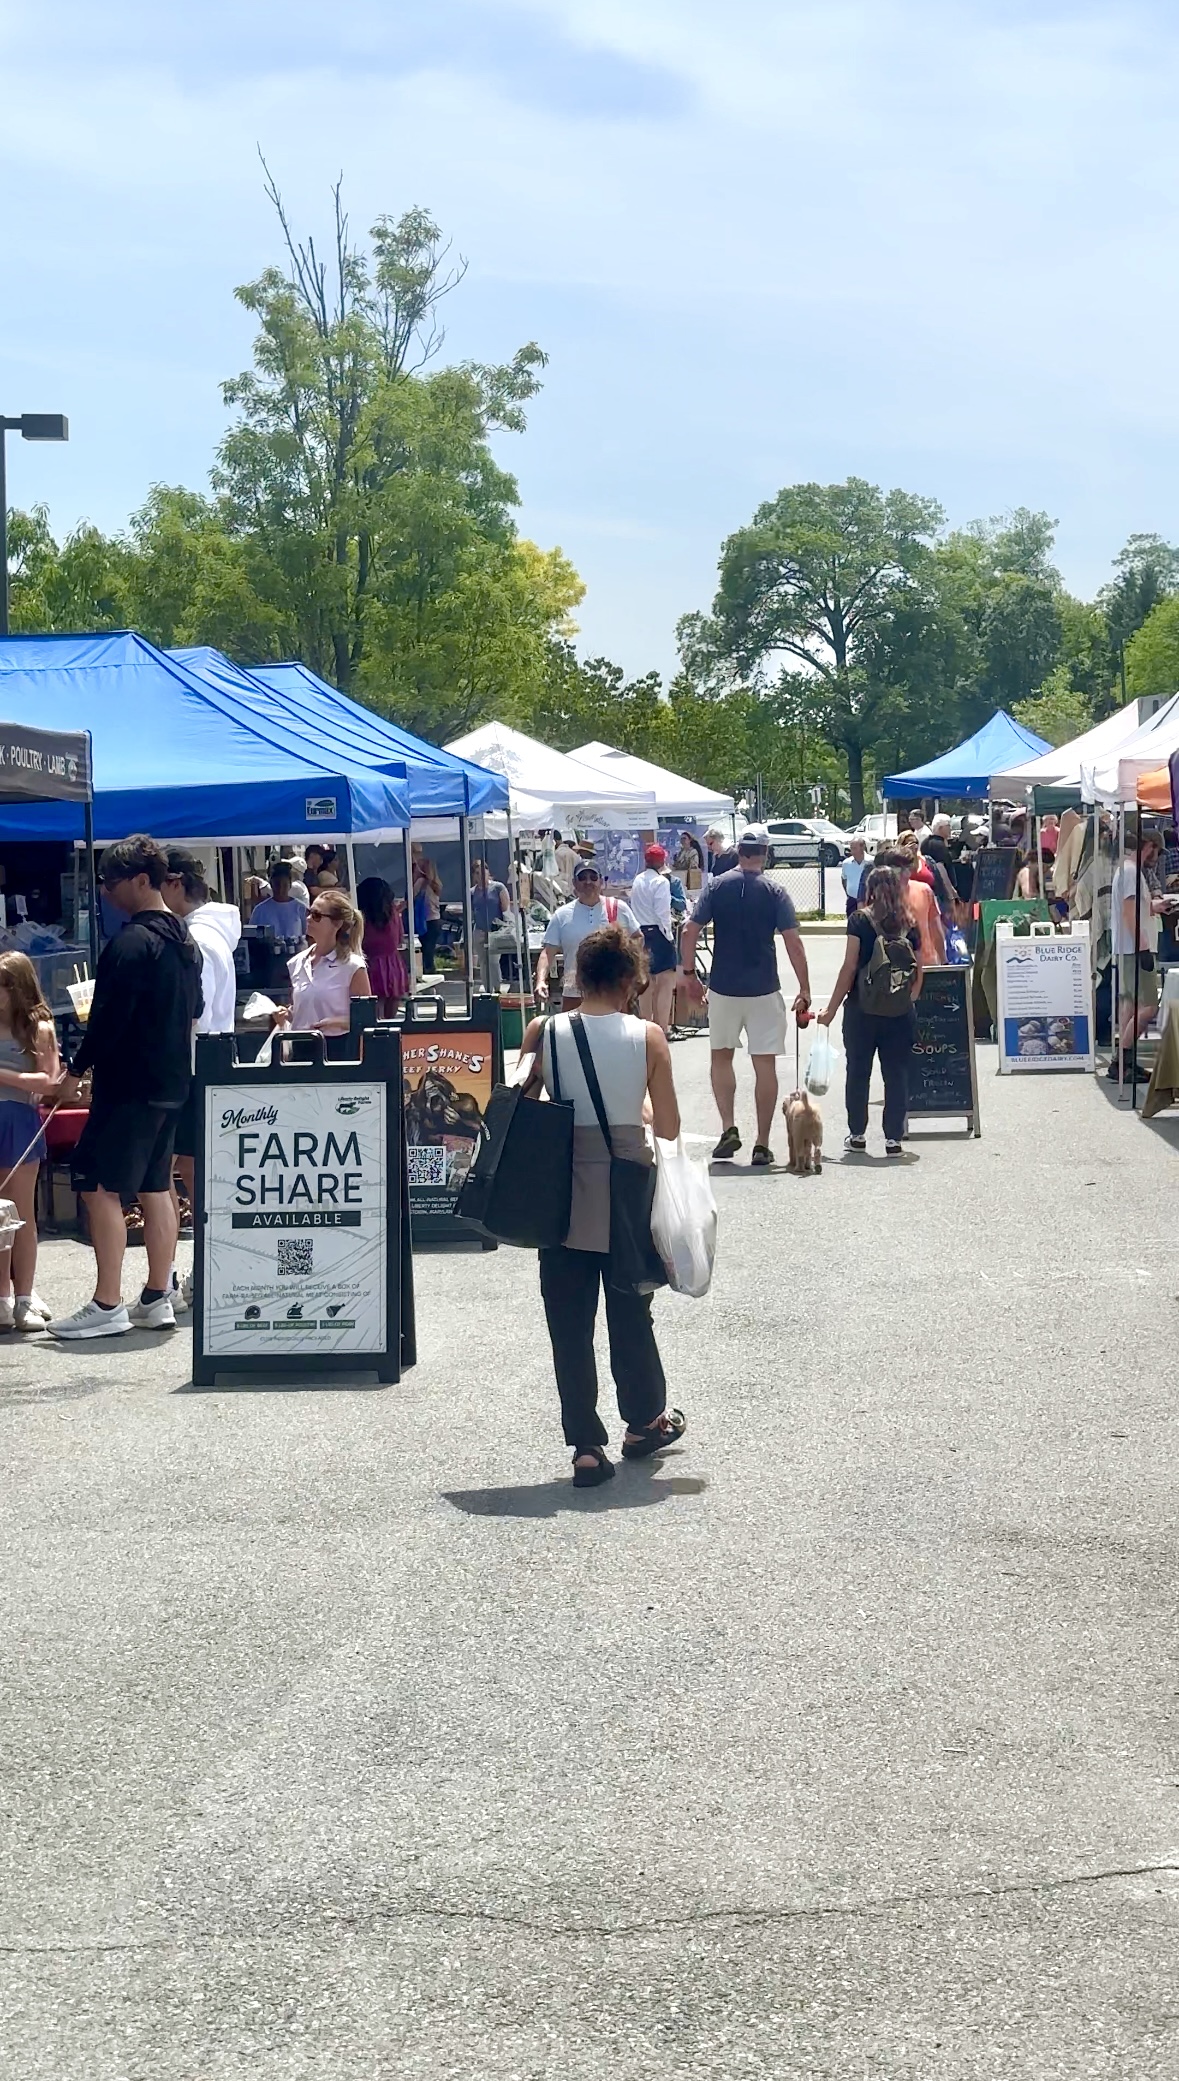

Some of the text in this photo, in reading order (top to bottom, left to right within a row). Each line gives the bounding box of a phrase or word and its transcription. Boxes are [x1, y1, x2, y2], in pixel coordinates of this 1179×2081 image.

[11, 745, 43, 772] POULTRY
[47, 754, 66, 776] LAMB
[1035, 946, 1082, 954] BLUE RIDGE
[403, 1047, 426, 1061] HER
[403, 1065, 462, 1074] EEF JERKY
[221, 1105, 279, 1129] Monthly
[238, 1131, 362, 1169] FARM
[235, 1172, 363, 1206] SHARE
[252, 1213, 343, 1226] AVAILABLE
